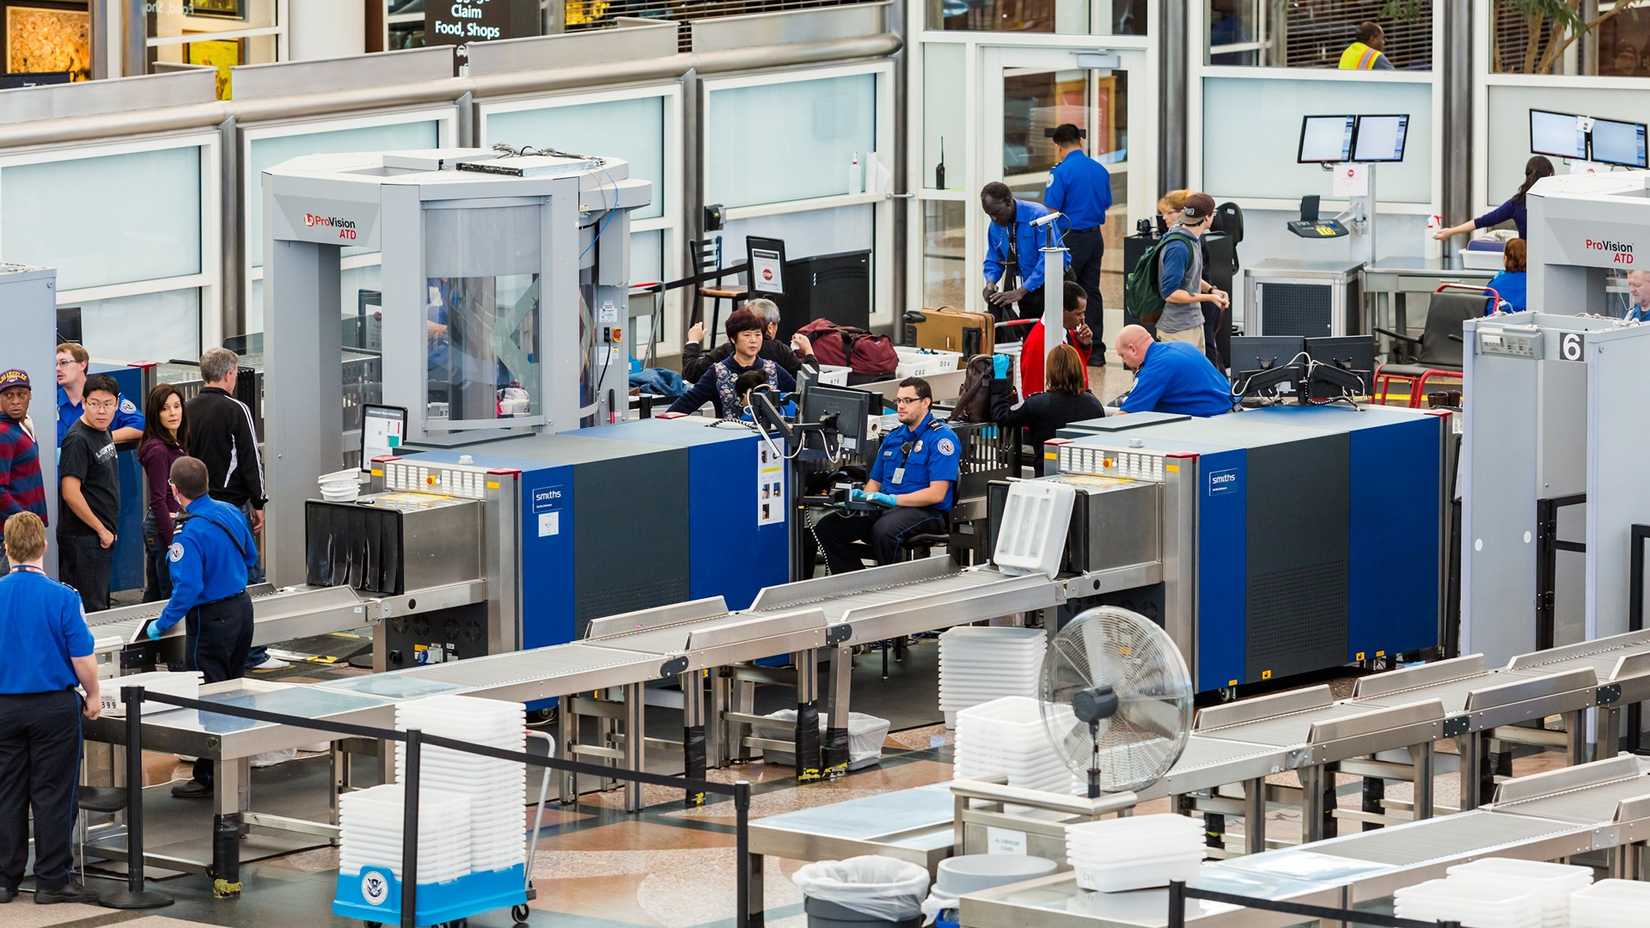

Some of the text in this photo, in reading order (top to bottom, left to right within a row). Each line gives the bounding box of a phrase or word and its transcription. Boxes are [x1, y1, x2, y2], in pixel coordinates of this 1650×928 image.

[451, 4, 482, 18] Claim
[435, 21, 500, 39] Food, Shops
[315, 216, 356, 229] ProVision
[339, 230, 357, 240] ATD
[1585, 239, 1633, 253] ProVision
[1613, 253, 1634, 264] ATD
[1563, 333, 1581, 361] 6
[1212, 474, 1236, 485] smiths
[535, 490, 562, 501] smiths
